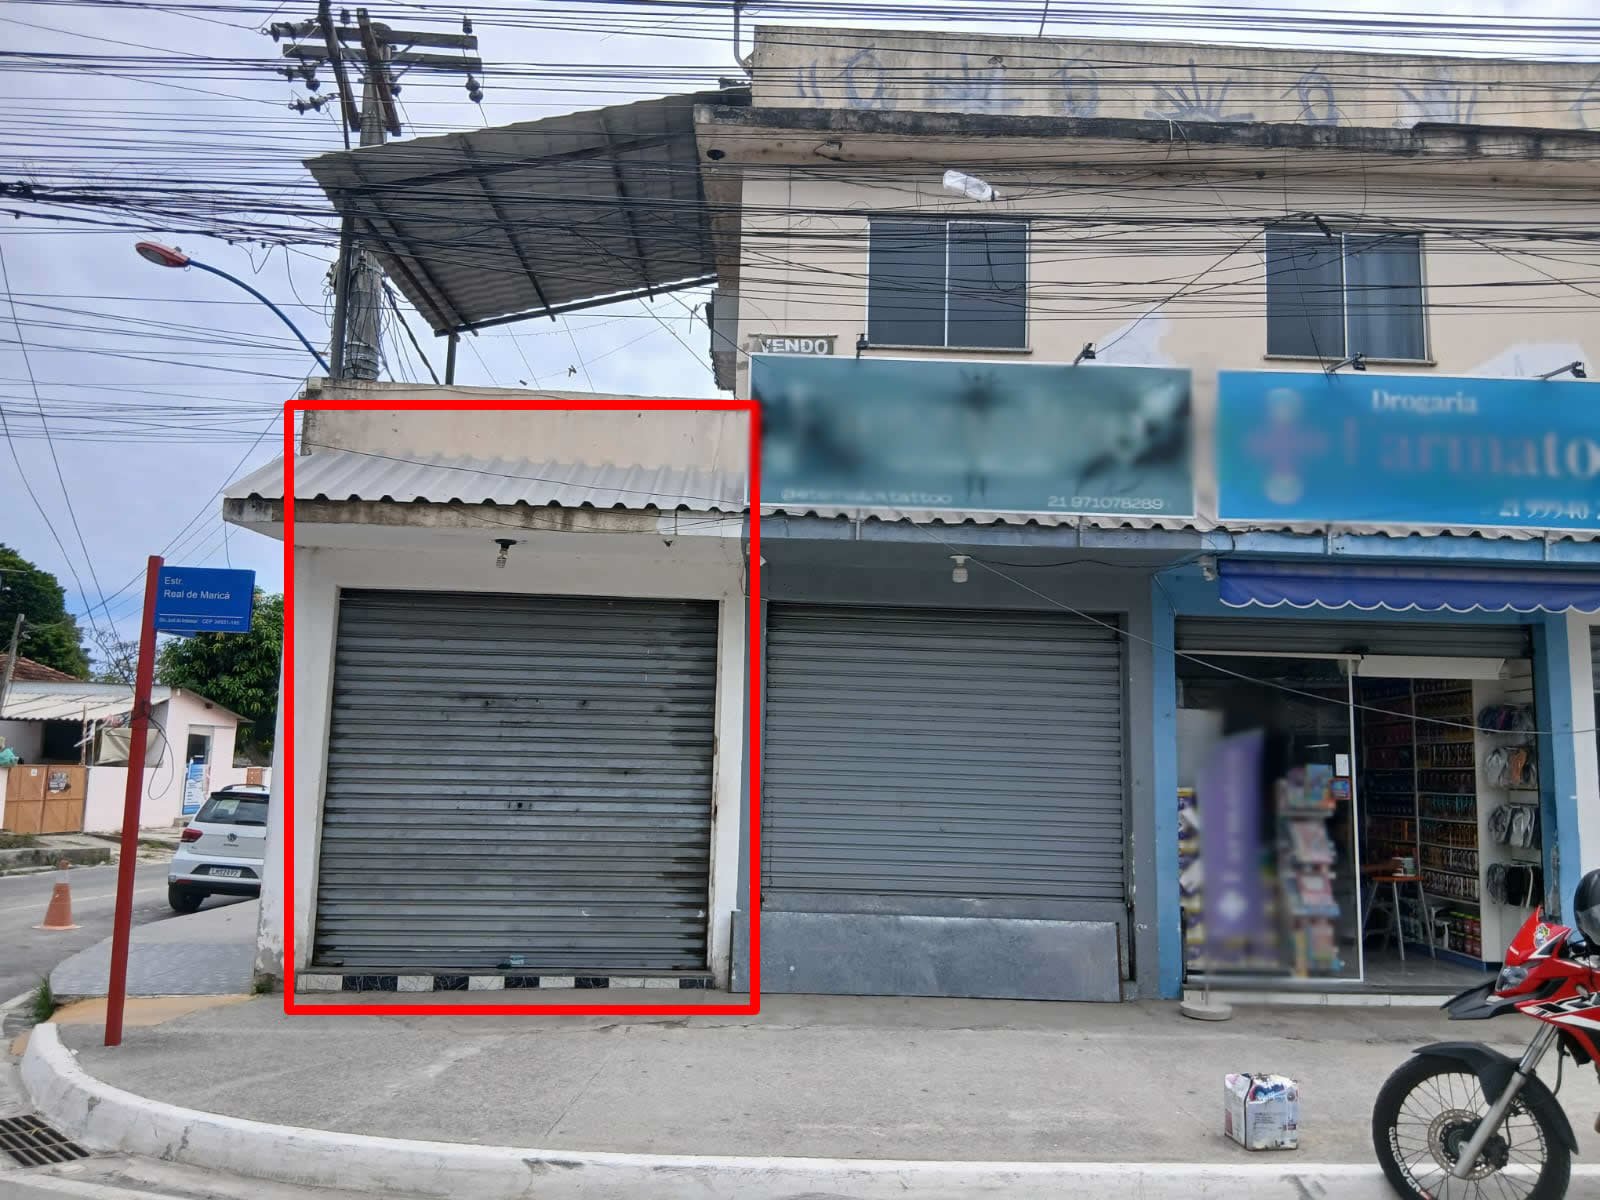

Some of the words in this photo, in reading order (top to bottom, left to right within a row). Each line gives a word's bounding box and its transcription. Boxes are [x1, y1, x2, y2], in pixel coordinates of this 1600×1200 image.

[759, 338, 829, 355] VENDO
[1372, 388, 1478, 415] Drogaria
[1047, 495, 1067, 508] 21
[163, 589, 185, 599] Real
[186, 590, 198, 599] de
[200, 590, 231, 600] Maricá
